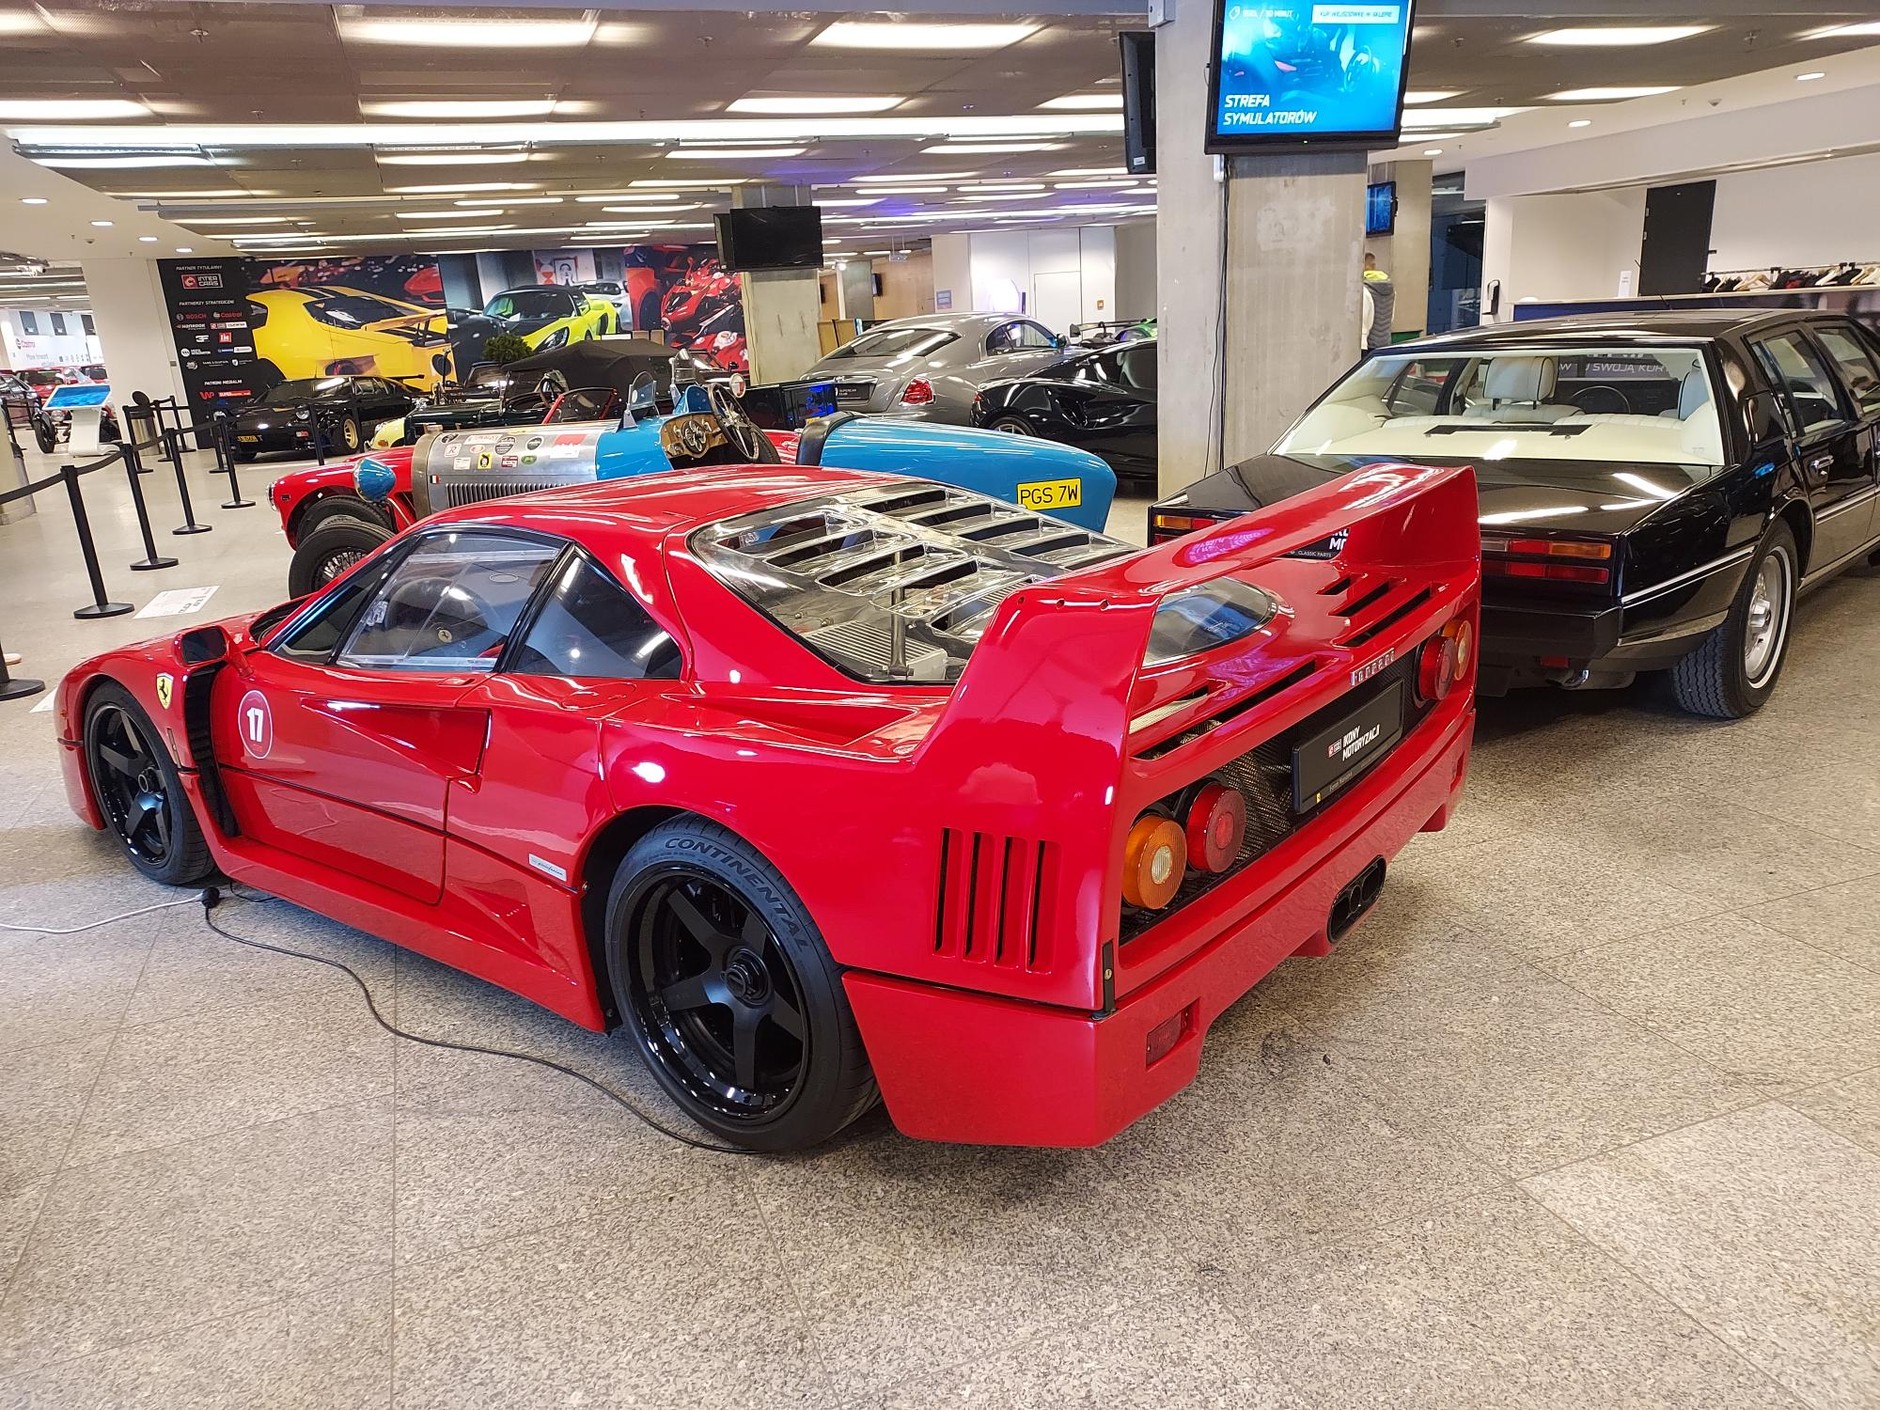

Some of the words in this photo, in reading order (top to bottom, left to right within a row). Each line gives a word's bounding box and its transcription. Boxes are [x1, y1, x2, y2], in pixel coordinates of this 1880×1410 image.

[1224, 94, 1270, 108] STREFA
[1223, 109, 1317, 126] SYMULATORÓW
[1593, 363, 1634, 373] SWOJĄ
[1020, 487, 1053, 504] PGS
[1058, 484, 1078, 502] 7W
[1351, 650, 1396, 686] Ferrari
[247, 707, 263, 743] 17
[1343, 725, 1361, 748] IKONY
[664, 837, 809, 953] CONTINENTAL
